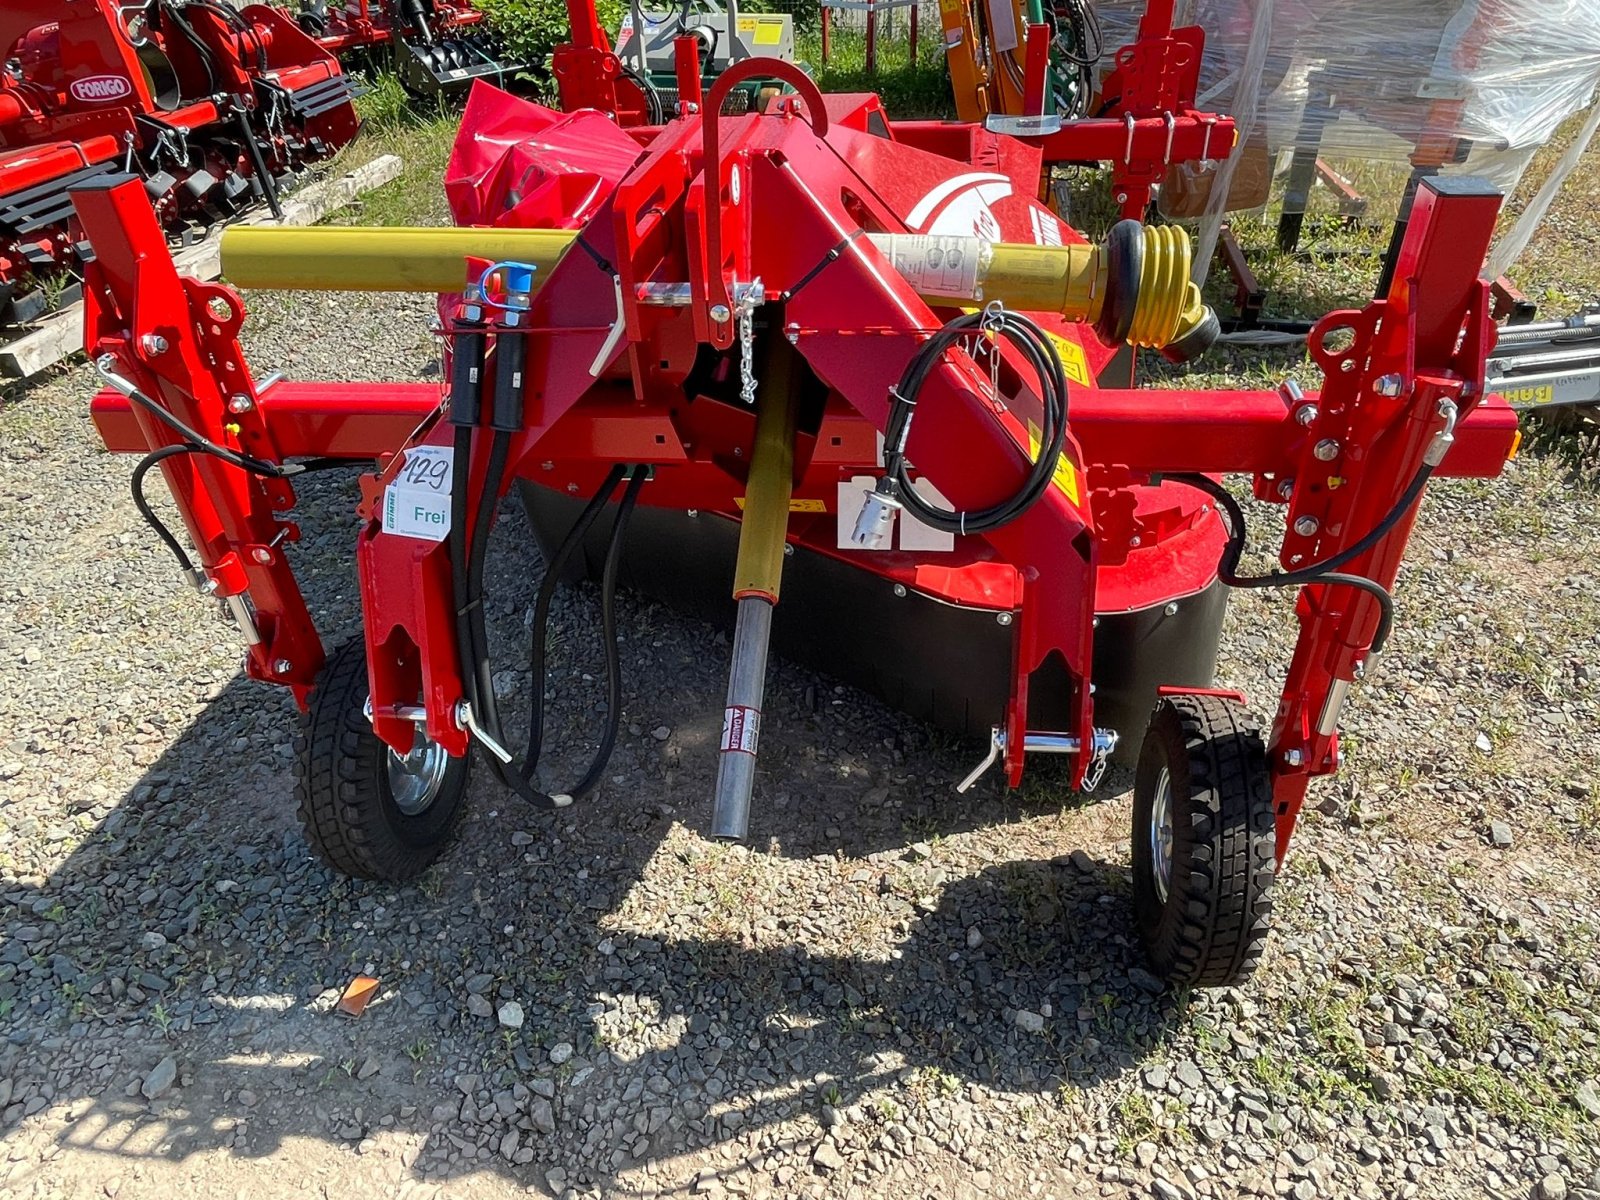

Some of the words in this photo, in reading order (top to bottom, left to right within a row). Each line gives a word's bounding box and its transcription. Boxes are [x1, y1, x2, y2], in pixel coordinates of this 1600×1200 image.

[76, 79, 125, 98] FORIGO
[1499, 384, 1553, 406] BÄH
[404, 455, 449, 490] 129
[387, 492, 396, 529] GRIMME
[414, 506, 446, 525] Frei
[731, 719, 742, 749] DANGER
